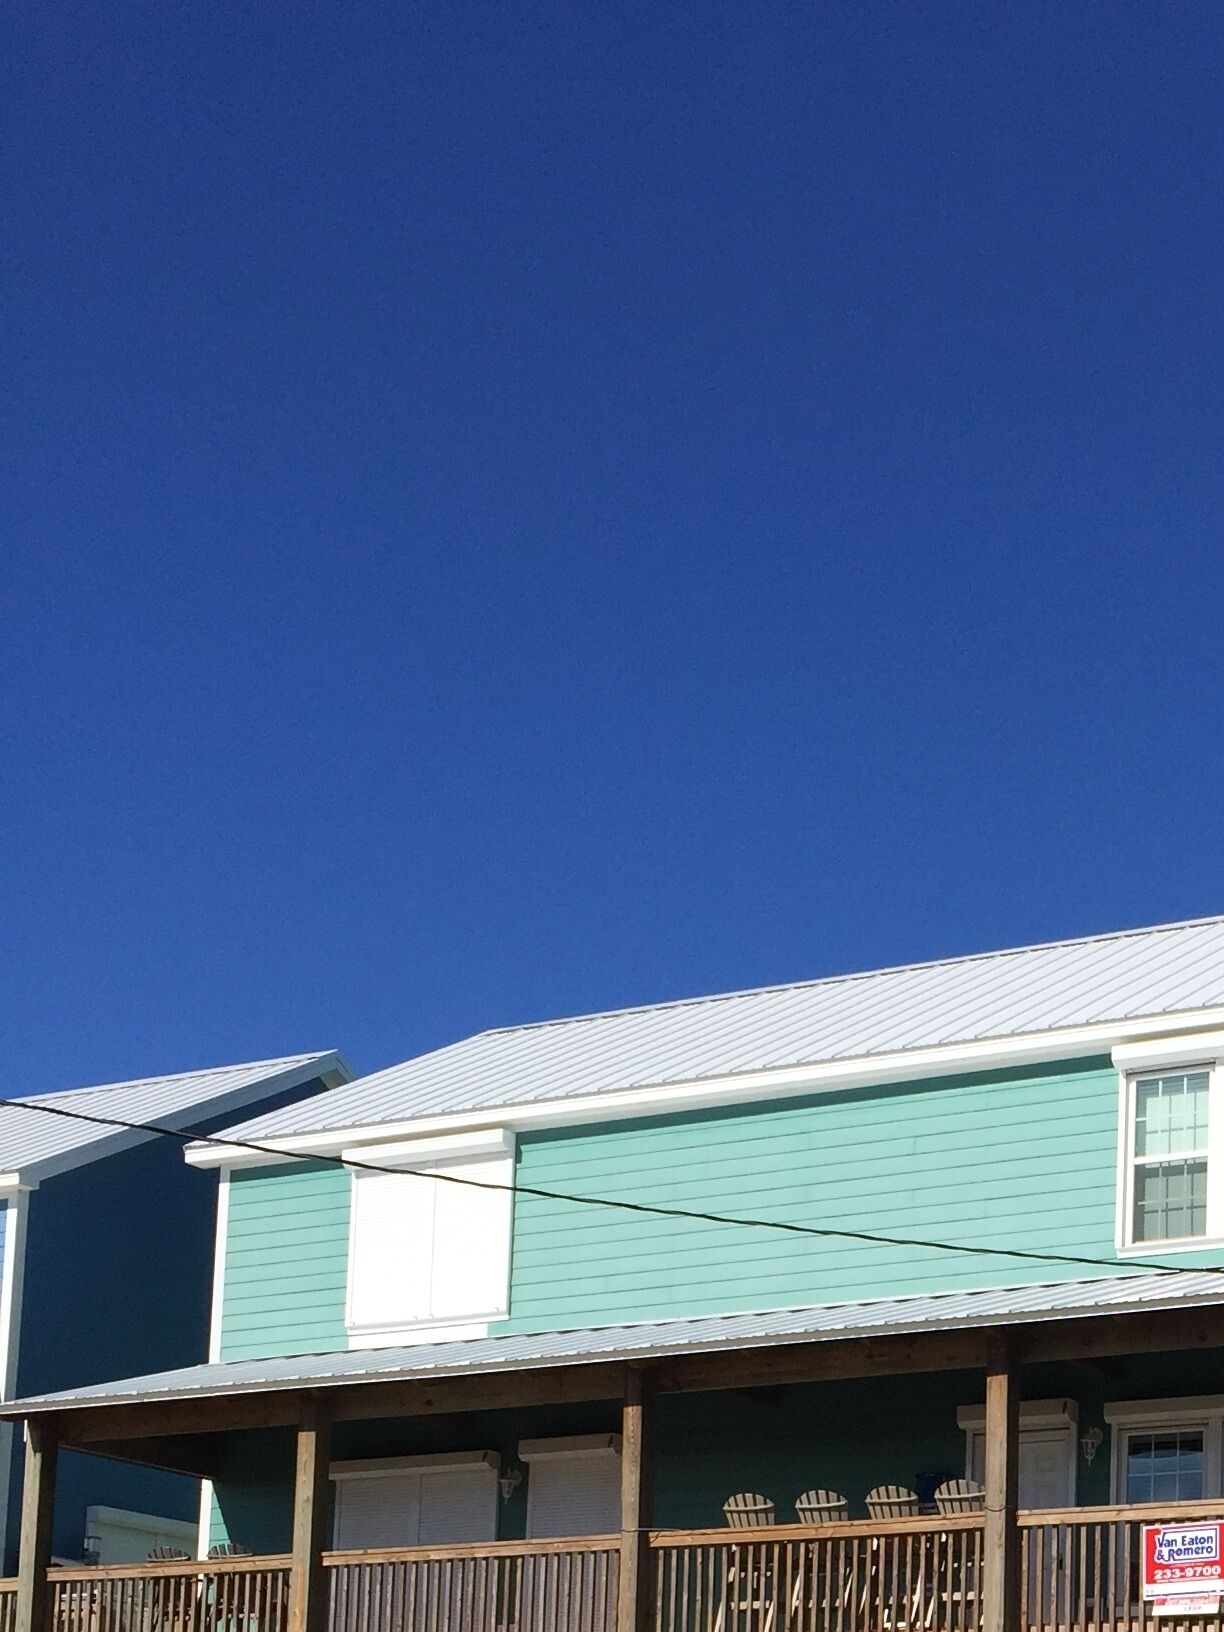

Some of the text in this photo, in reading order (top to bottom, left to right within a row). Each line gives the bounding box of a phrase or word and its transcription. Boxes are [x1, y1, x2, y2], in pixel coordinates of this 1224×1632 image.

[1157, 1533, 1213, 1547] Van Eaton
[1157, 1546, 1213, 1561] & Romero
[1154, 1566, 1221, 1580] 233-9700
